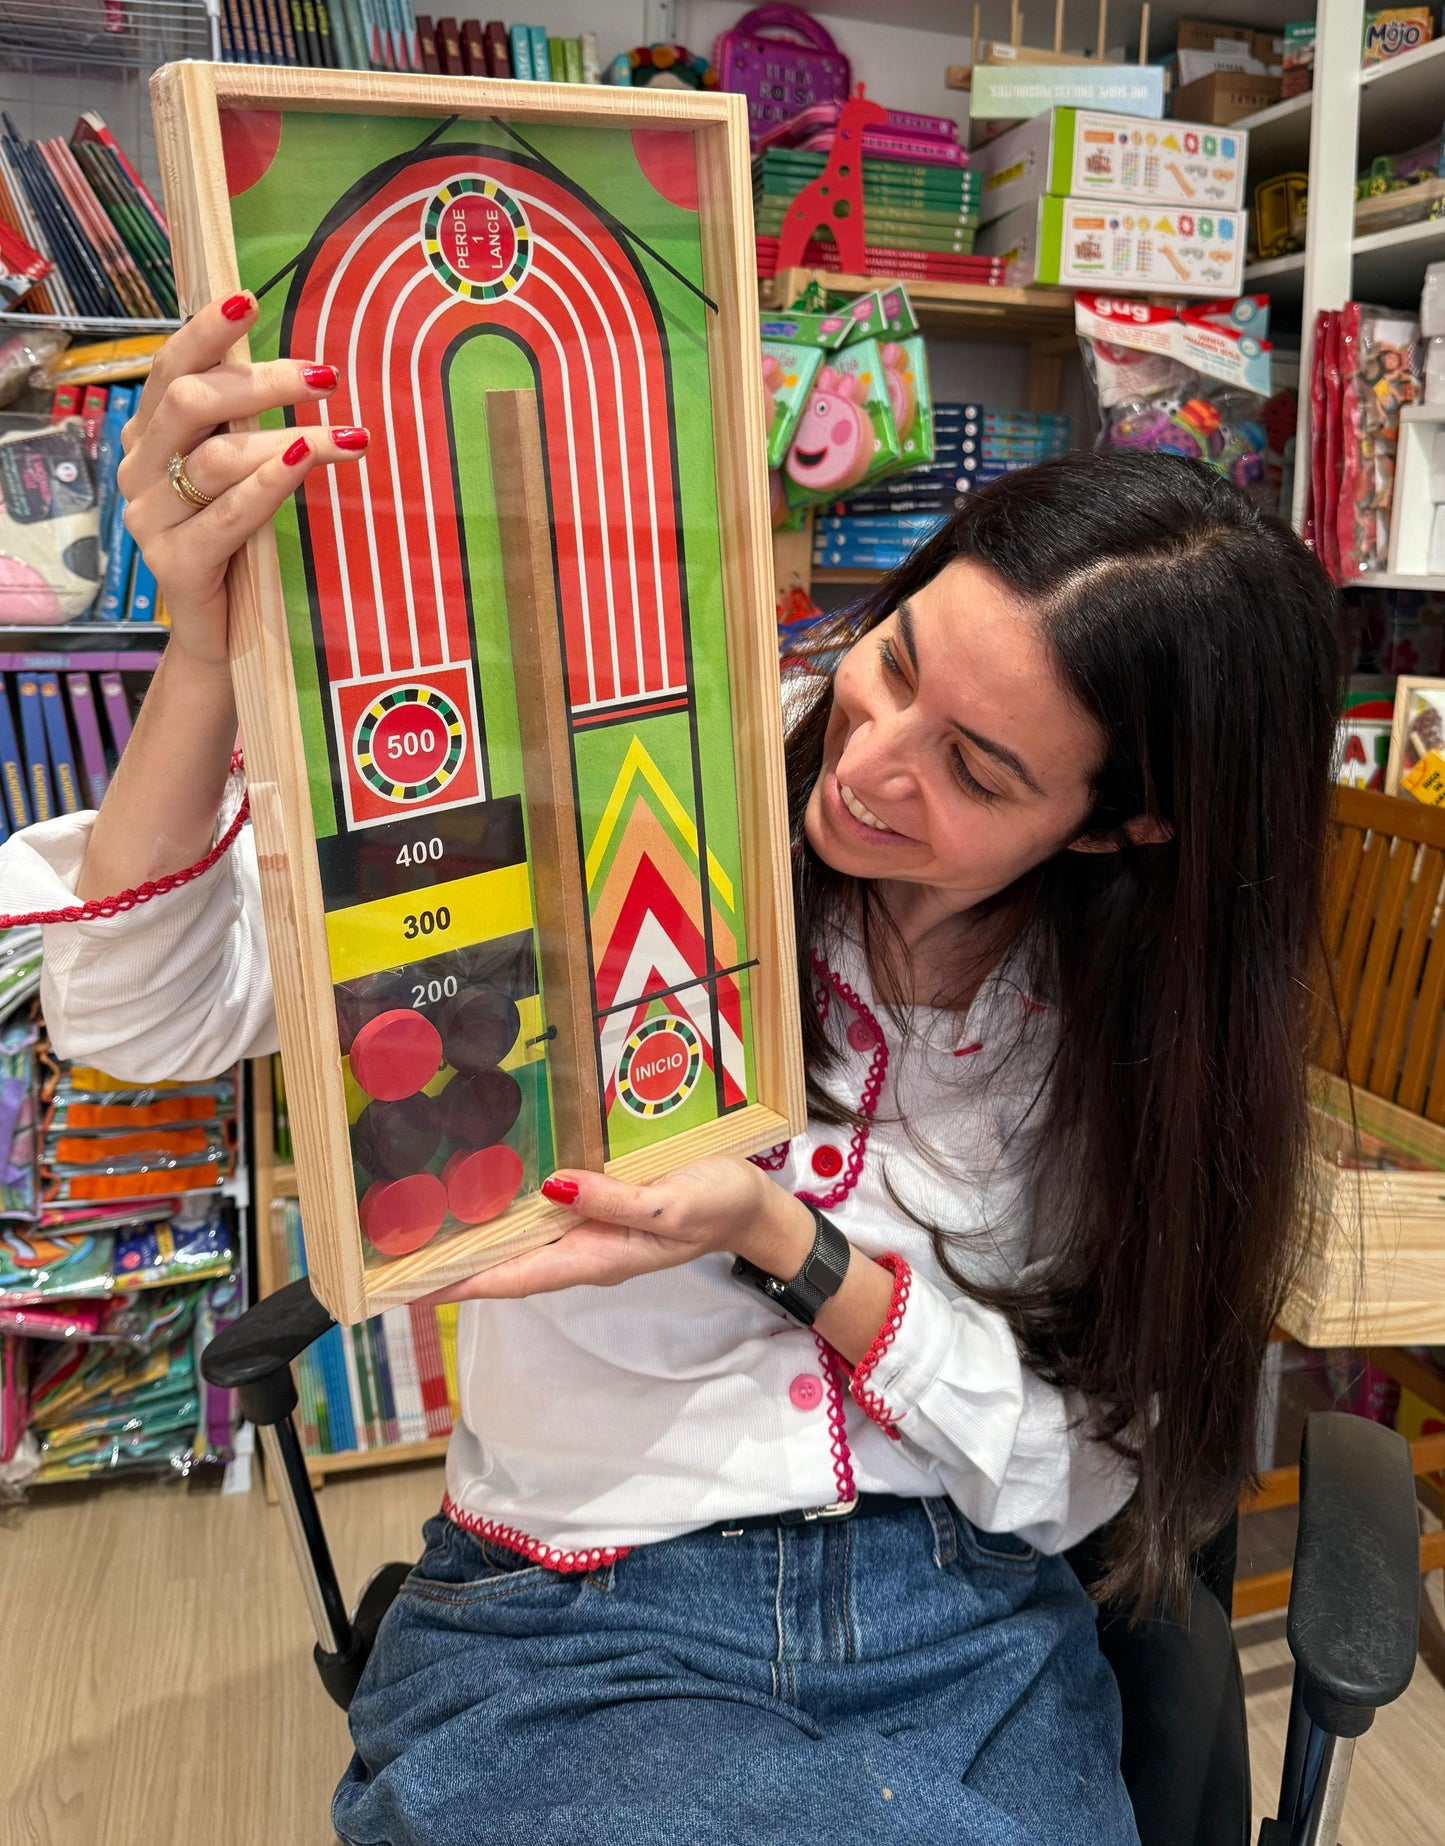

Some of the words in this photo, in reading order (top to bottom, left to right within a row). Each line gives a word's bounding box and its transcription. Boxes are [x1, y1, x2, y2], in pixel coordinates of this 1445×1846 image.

[1365, 21, 1420, 54] Mojo
[452, 208, 470, 269] PERDE
[472, 236, 484, 244] 1
[486, 209, 504, 269] LANCE
[387, 728, 435, 759] 500
[396, 837, 444, 868] 400
[403, 906, 451, 939] 300
[411, 975, 458, 1009] 200
[635, 1053, 683, 1082] INICIO
